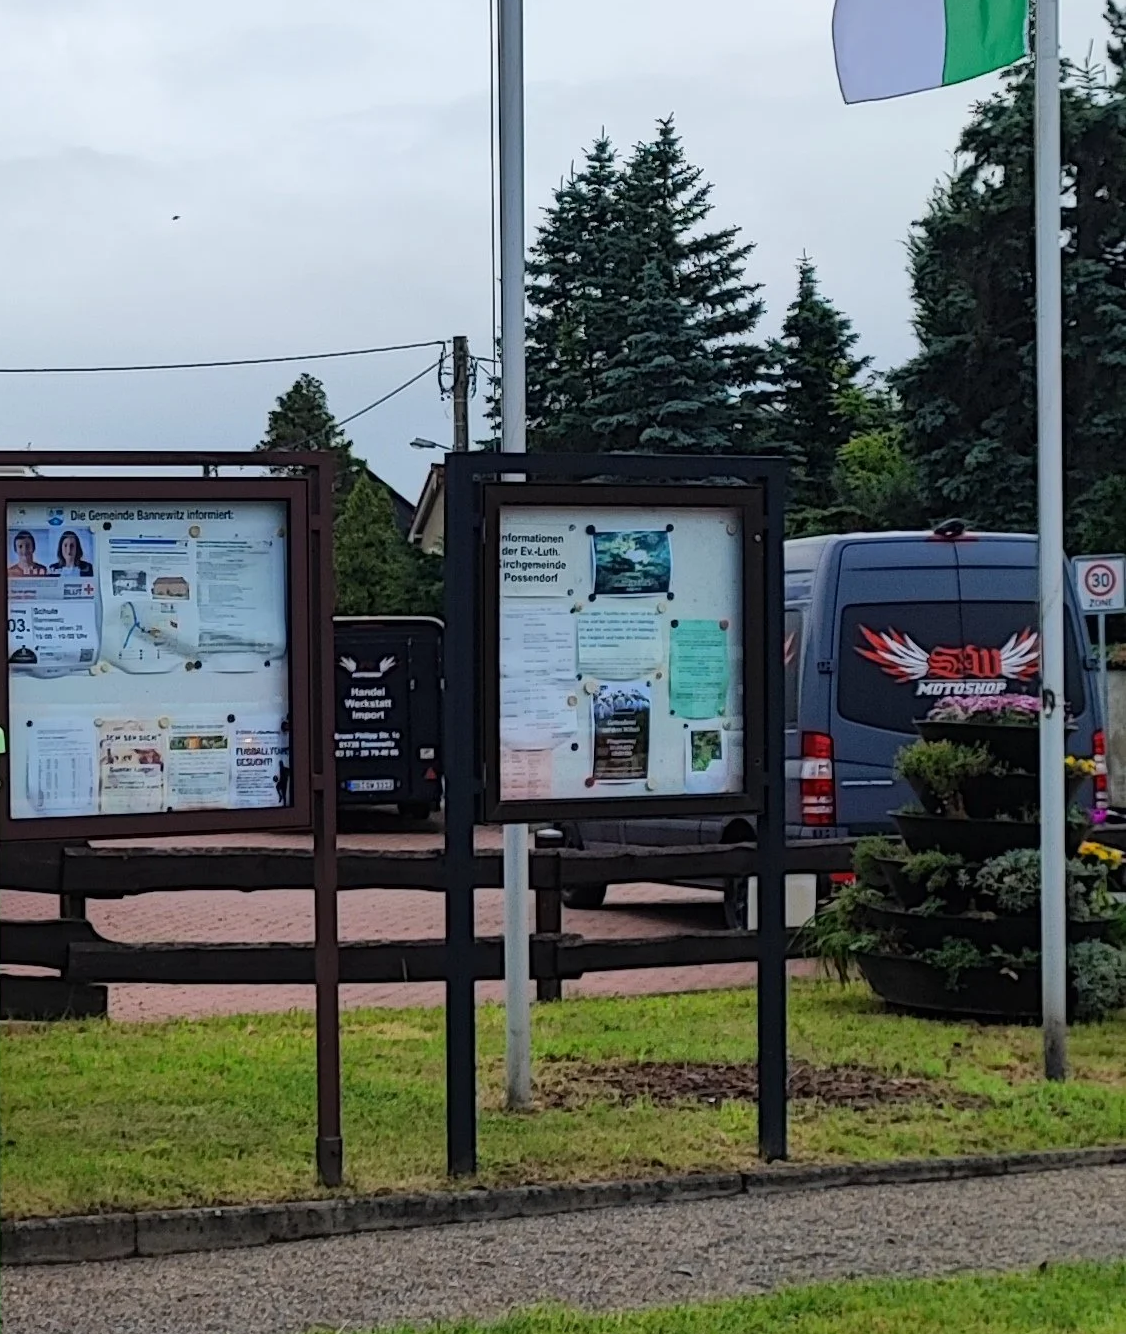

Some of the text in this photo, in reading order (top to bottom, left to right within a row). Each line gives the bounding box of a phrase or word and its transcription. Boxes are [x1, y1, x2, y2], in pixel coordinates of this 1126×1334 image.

[70, 510, 86, 521] Die
[88, 510, 134, 521] Gemeinde
[137, 510, 184, 521] Bannewitz
[501, 533, 564, 544] nformationen
[501, 547, 561, 557] der Ev.-Luth.
[501, 560, 567, 572] irchgemeinde
[504, 572, 559, 583] Possendorf
[1091, 572, 1110, 588] 30
[1089, 598, 1113, 608] ZONE
[351, 687, 386, 697] Handel
[916, 682, 1008, 696] MOTOSHOP
[344, 698, 393, 709] Werkstatt
[351, 710, 385, 721] Import
